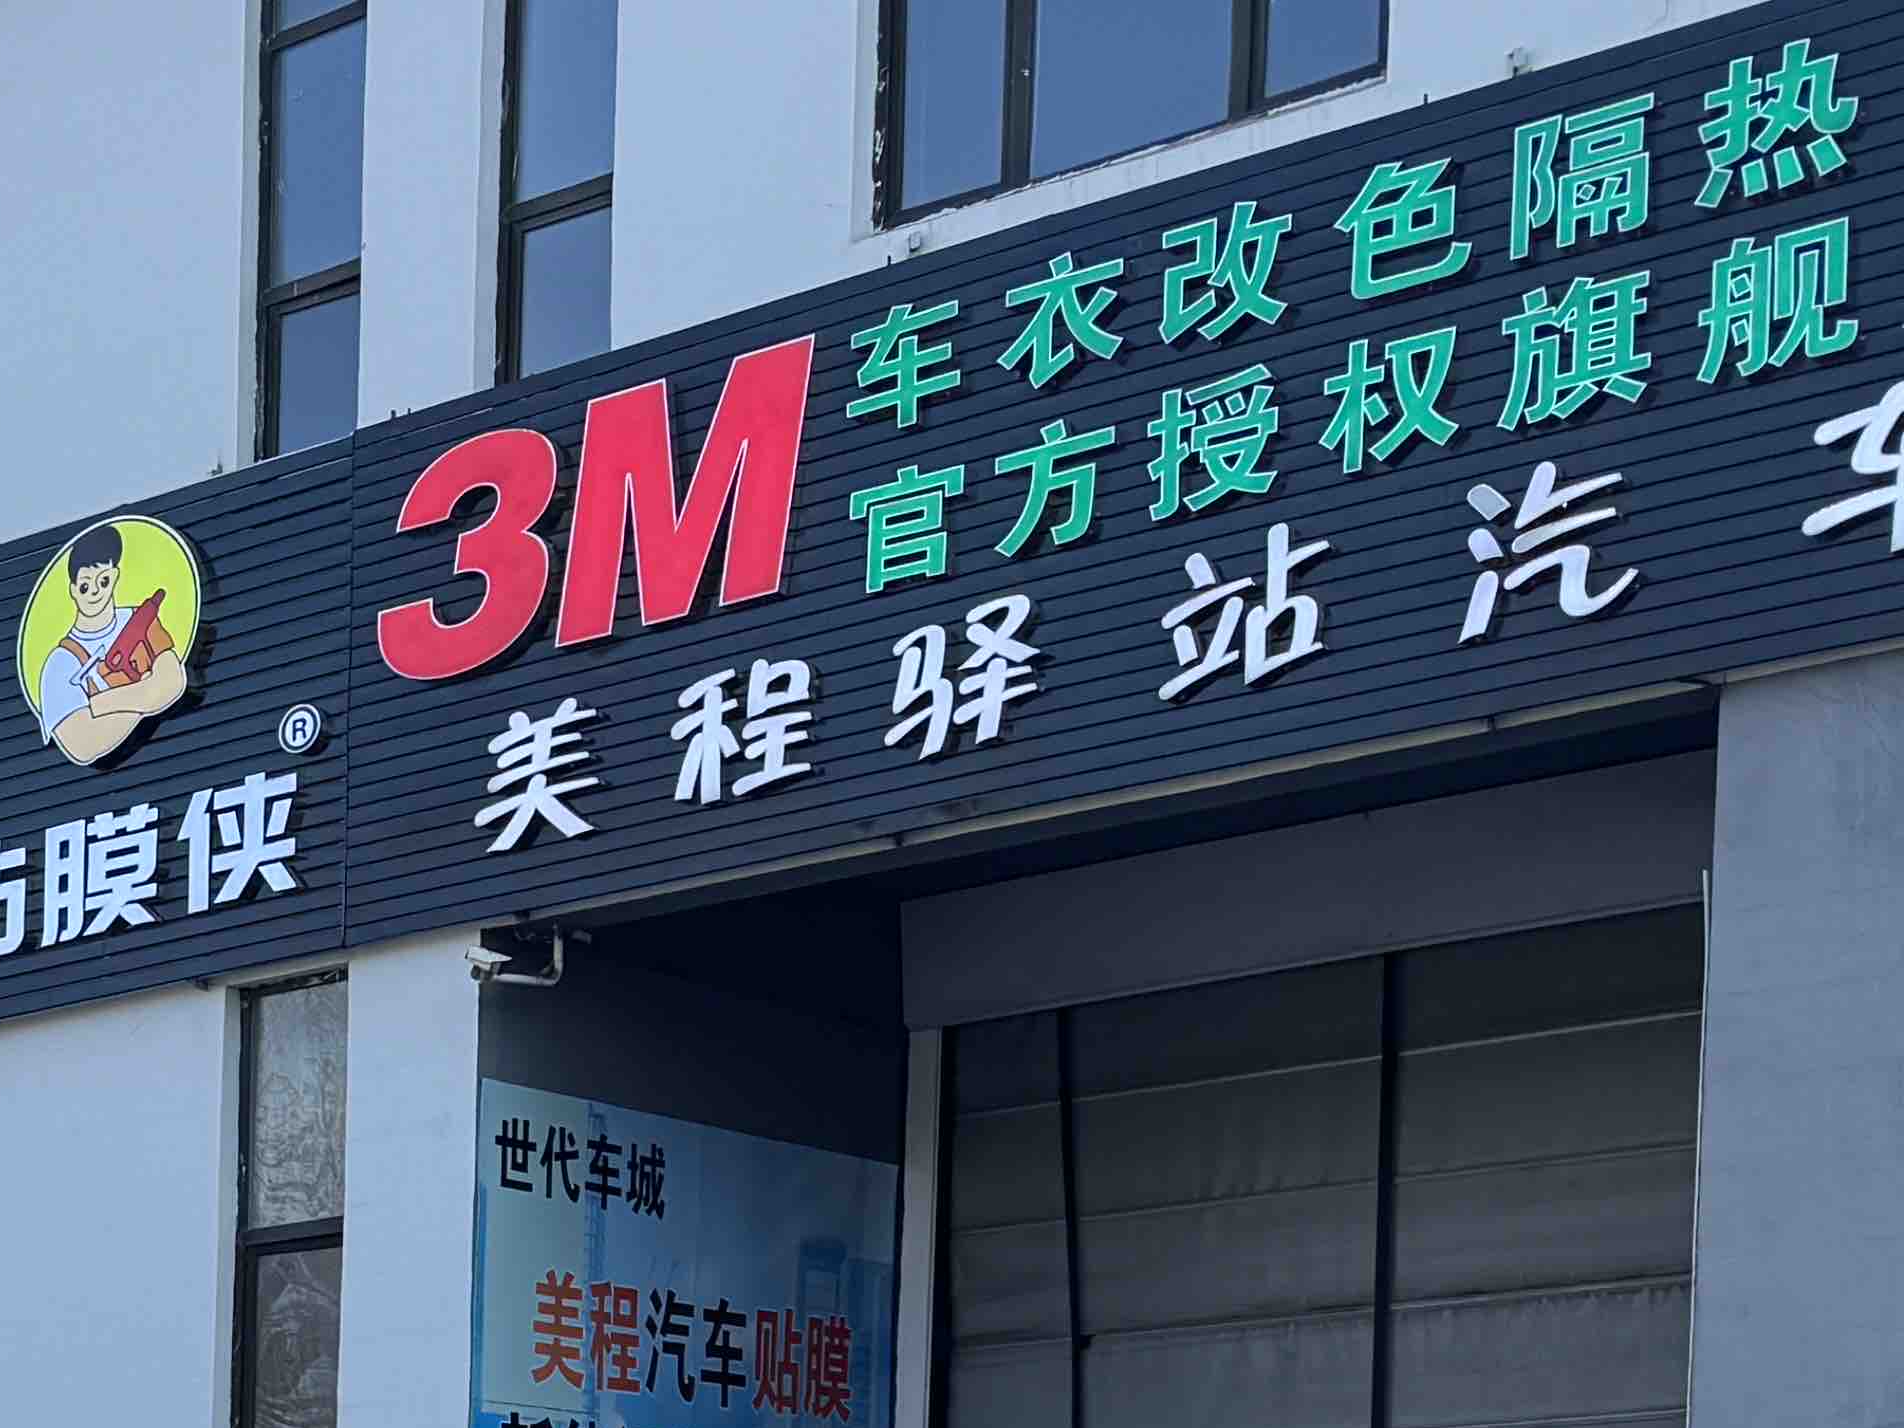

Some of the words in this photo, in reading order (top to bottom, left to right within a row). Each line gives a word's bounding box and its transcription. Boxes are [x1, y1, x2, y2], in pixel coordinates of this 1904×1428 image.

[847, 38, 1860, 428] 车衣改色隔热
[849, 217, 1860, 594] 官方授权旗舰
[377, 334, 816, 680] 3M
[495, 1118, 666, 1221] 世代车城
[531, 1269, 851, 1420] 美程汽车贴膜
